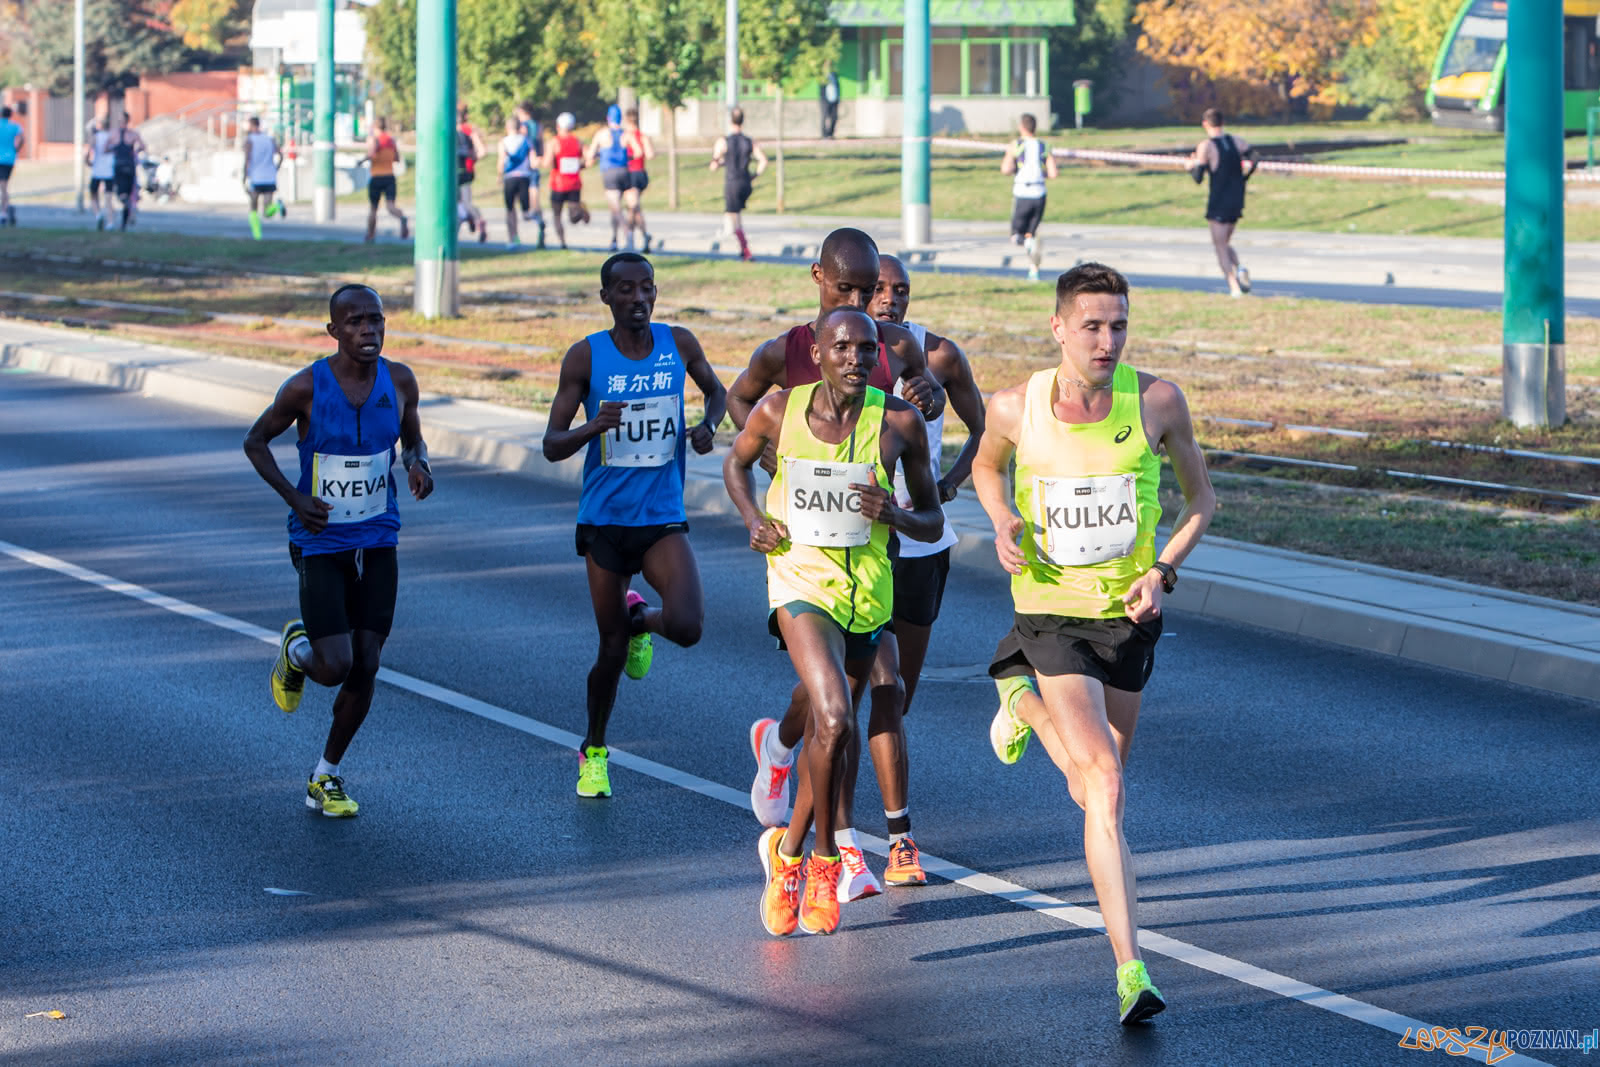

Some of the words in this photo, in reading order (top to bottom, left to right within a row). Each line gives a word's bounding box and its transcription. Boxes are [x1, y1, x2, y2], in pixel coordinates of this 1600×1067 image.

[608, 371, 672, 394] 海尔斯
[614, 417, 676, 442] TUFA
[322, 474, 386, 498] KYEVA
[794, 488, 862, 512] SANG
[1046, 502, 1134, 529] KULKA
